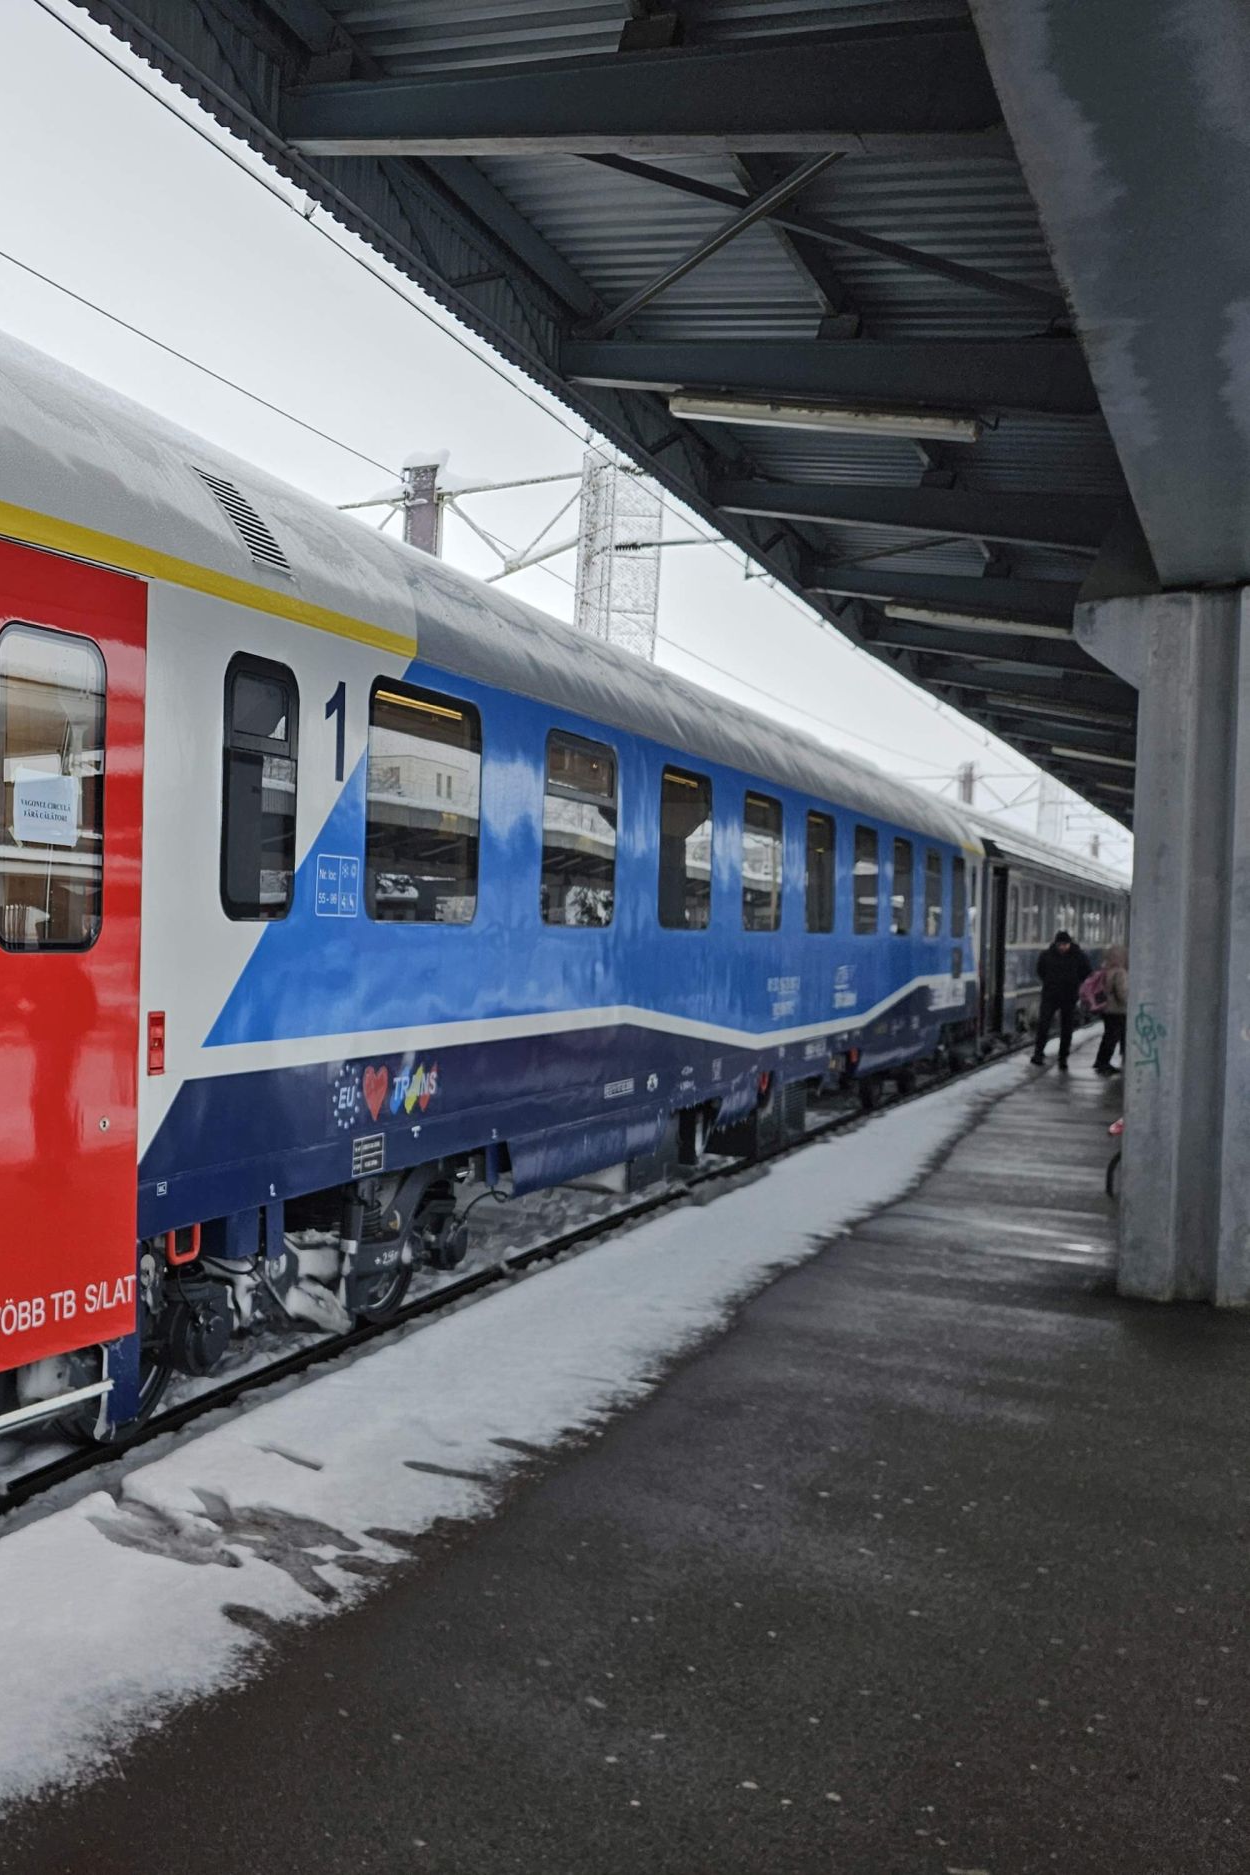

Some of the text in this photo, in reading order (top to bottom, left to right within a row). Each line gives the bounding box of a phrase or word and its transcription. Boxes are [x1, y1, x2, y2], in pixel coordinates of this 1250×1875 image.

[325, 680, 346, 782] 1
[338, 1086, 356, 1110] EU
[393, 1071, 437, 1101] TRANS
[50, 1288, 77, 1322] TB
[84, 1275, 137, 1313] S/LAT
